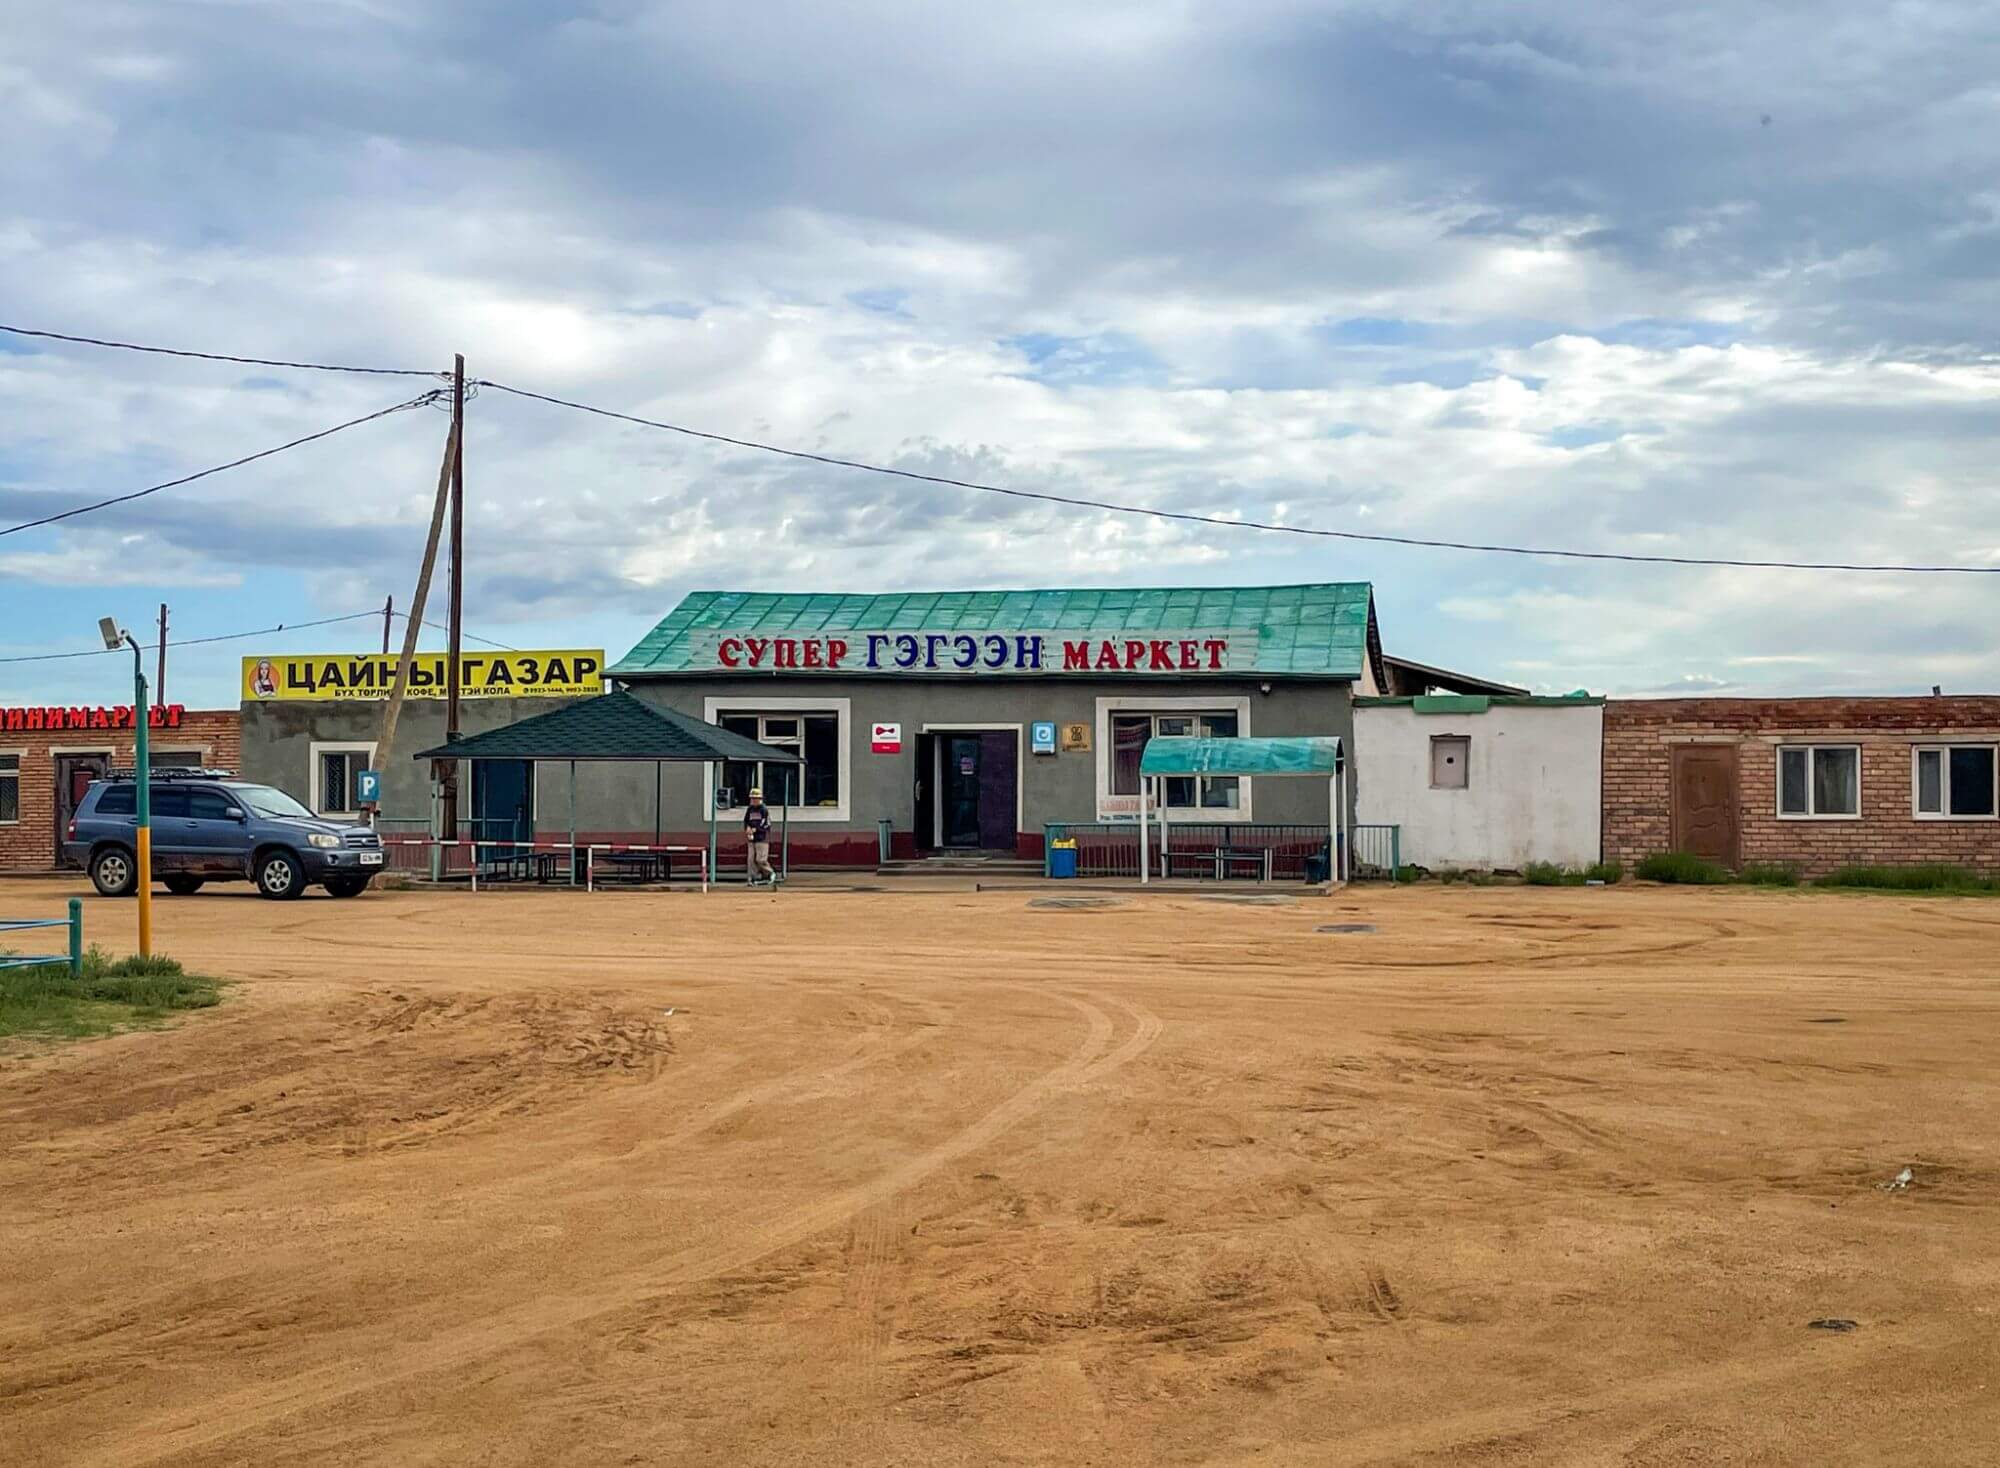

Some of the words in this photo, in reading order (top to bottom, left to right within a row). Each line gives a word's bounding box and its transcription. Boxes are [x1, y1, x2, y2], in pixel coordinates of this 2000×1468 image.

[718, 638, 848, 668] СУПЕР
[866, 634, 1043, 669] ГЭГЭЭН
[1062, 640, 1227, 670] МАРКЕТ
[287, 655, 444, 693] ЦАЙНЫ
[462, 658, 597, 686] ГАЗАР
[483, 686, 511, 696] КОЛА
[363, 776, 375, 796] P
